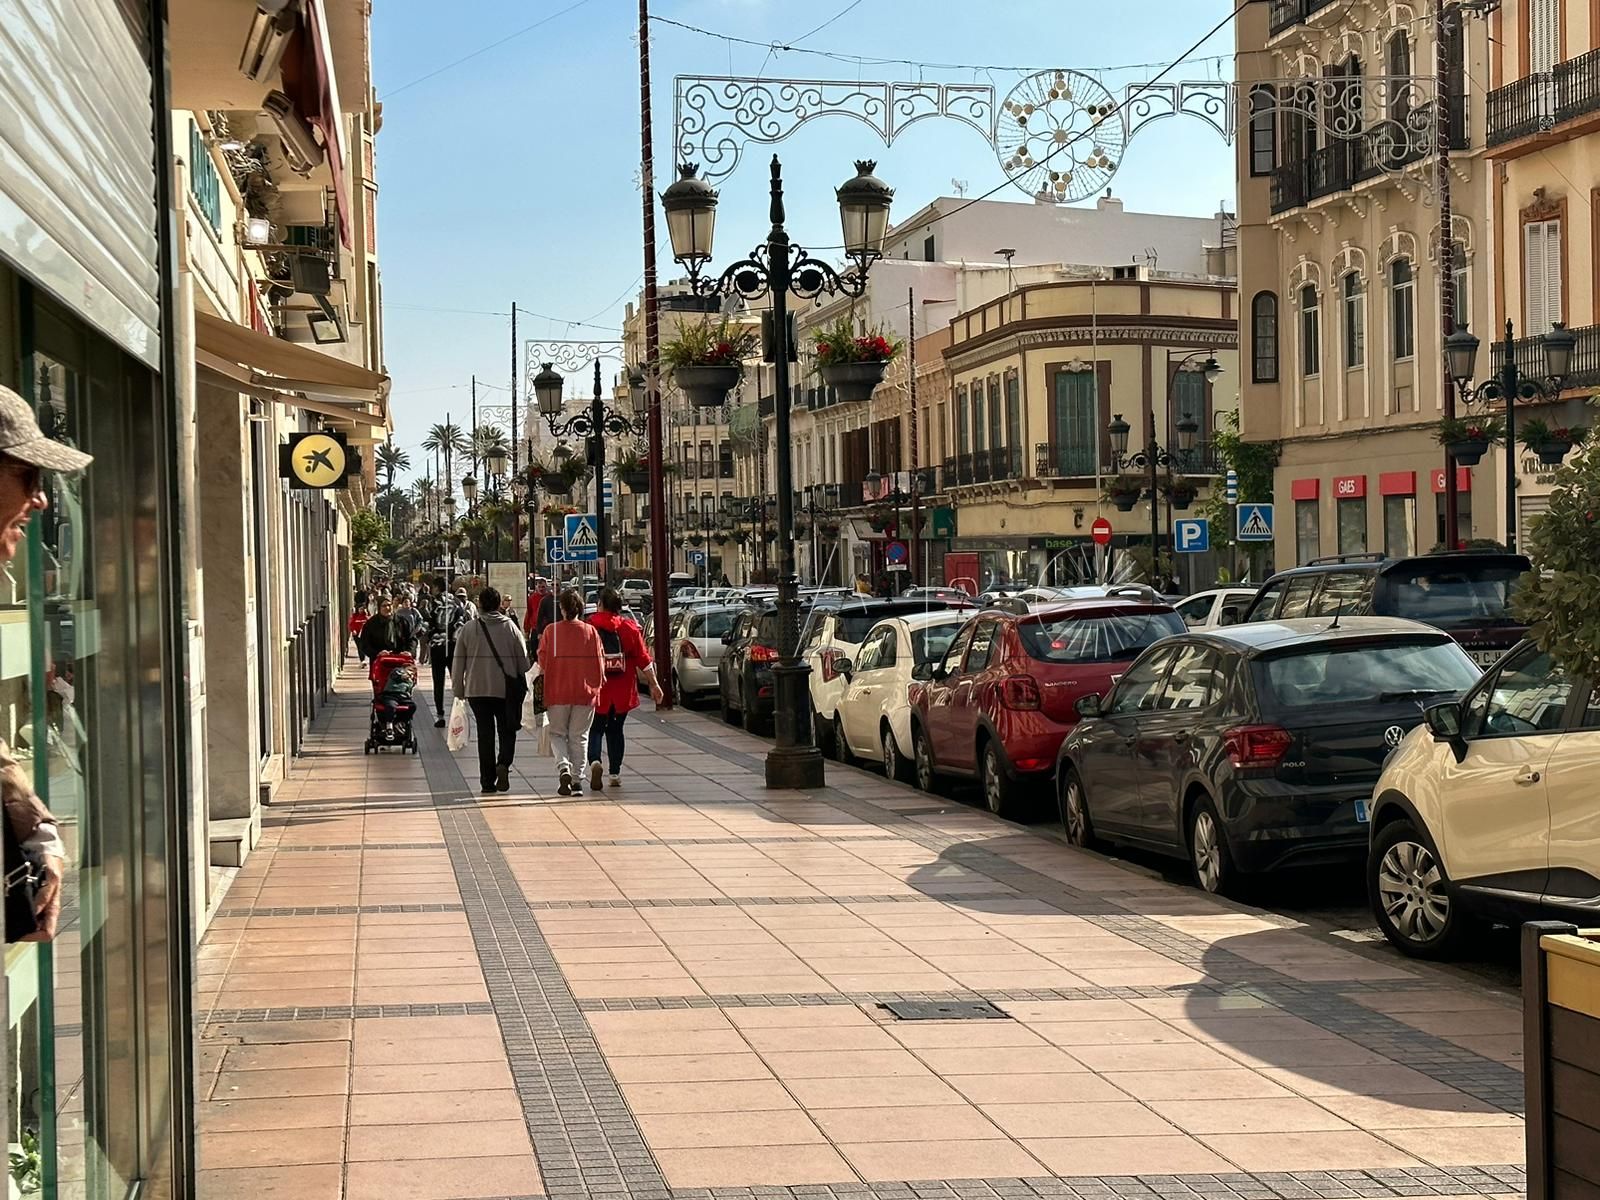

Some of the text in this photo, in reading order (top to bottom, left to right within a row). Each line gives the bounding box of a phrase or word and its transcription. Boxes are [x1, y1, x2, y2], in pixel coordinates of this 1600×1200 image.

[1338, 479, 1355, 494] GAES
[1181, 522, 1202, 548] P
[694, 553, 703, 565] P
[604, 659, 622, 669] ILA
